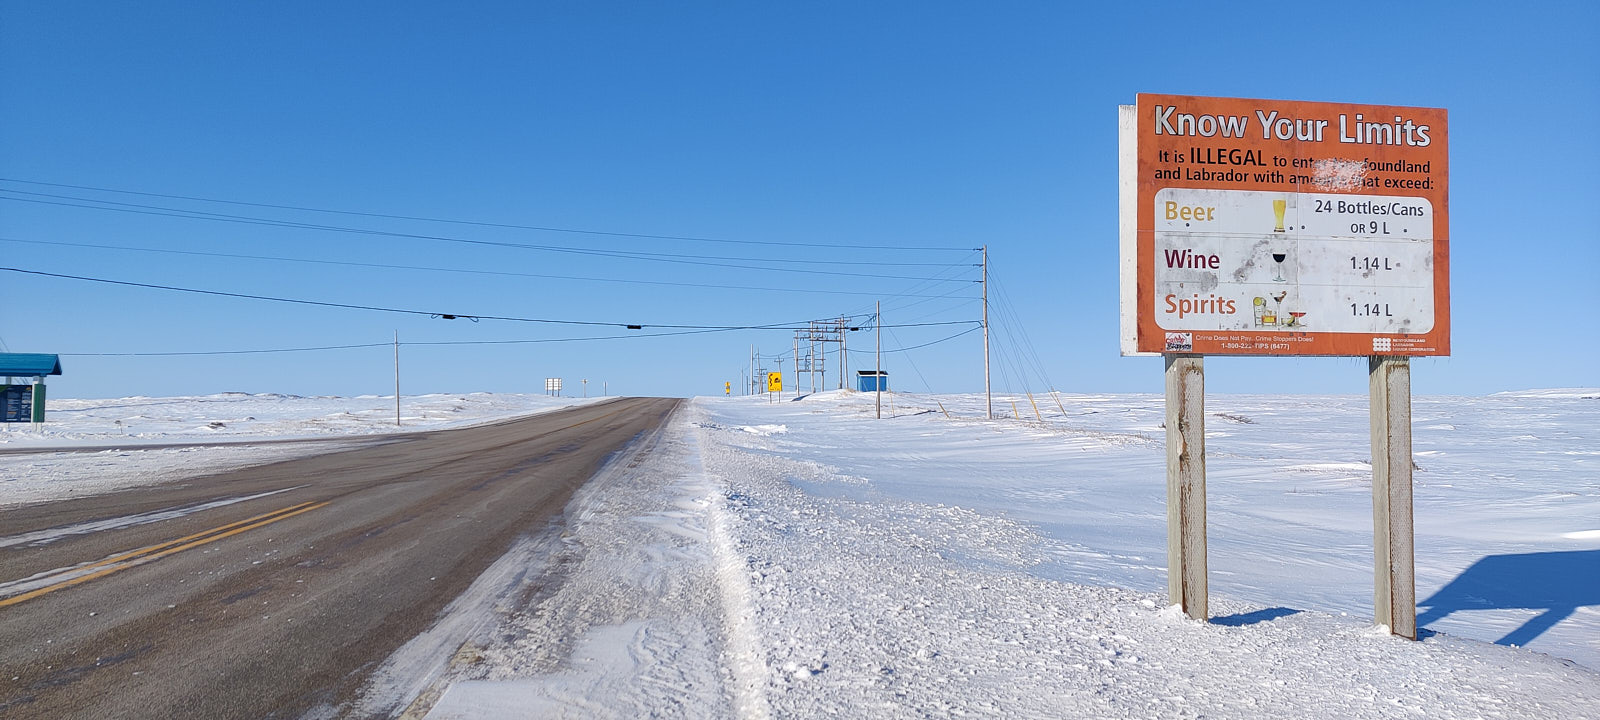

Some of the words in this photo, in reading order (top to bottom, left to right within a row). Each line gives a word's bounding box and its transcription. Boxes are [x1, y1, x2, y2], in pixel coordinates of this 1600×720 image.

[1154, 105, 1248, 138] Know
[1255, 110, 1328, 143] Your
[1339, 113, 1432, 148] Limits
[1158, 150, 1170, 163] It
[1174, 151, 1185, 163] is
[1190, 147, 1267, 167] ILLEGAL
[1272, 155, 1287, 167] to
[1292, 157, 1325, 170] ent
[1334, 157, 1431, 174] foundland
[1154, 166, 1181, 180] and
[1186, 167, 1249, 182] Labrador
[1253, 170, 1284, 184] with
[1384, 176, 1434, 190] exceed:
[1165, 200, 1215, 222] Beer
[1315, 200, 1332, 214] 24
[1337, 200, 1424, 217] Bottles/Cans
[1350, 223, 1366, 234] OR
[1369, 221, 1378, 234] 9
[1383, 221, 1390, 235] L
[1164, 248, 1220, 270] Wine
[1350, 256, 1380, 271] 1.14
[1384, 257, 1392, 271] L
[1165, 293, 1236, 317] Spirits
[1350, 303, 1380, 317] 1.14
[1385, 304, 1393, 318] L
